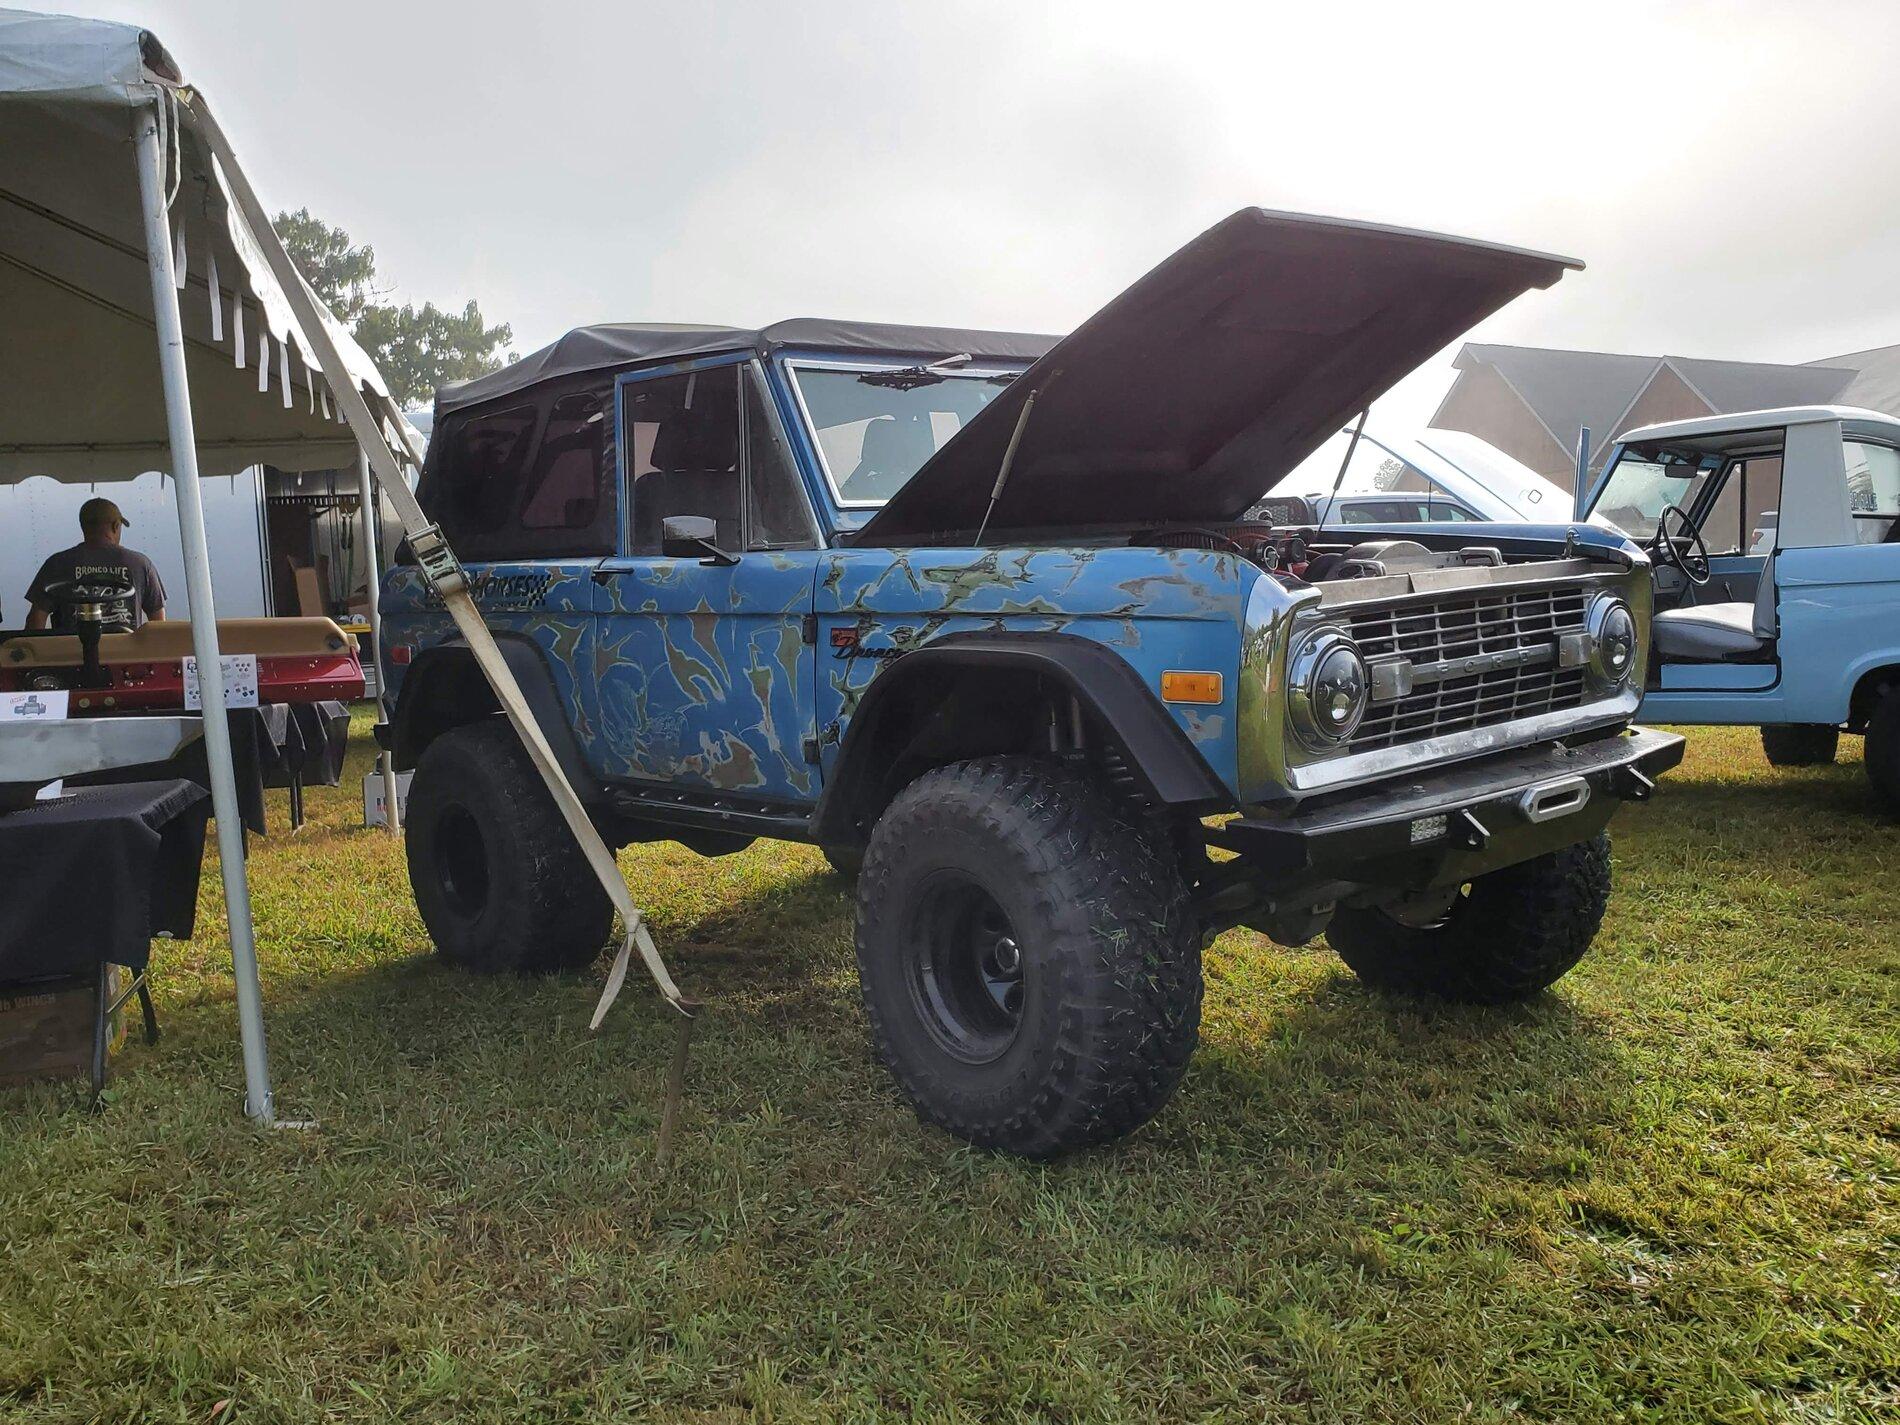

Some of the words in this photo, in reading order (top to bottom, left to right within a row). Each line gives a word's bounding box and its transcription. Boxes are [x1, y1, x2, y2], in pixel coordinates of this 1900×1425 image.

[75, 566, 108, 580] BRONCO
[109, 566, 129, 581] LIFE
[1436, 650, 1530, 675] FORD
